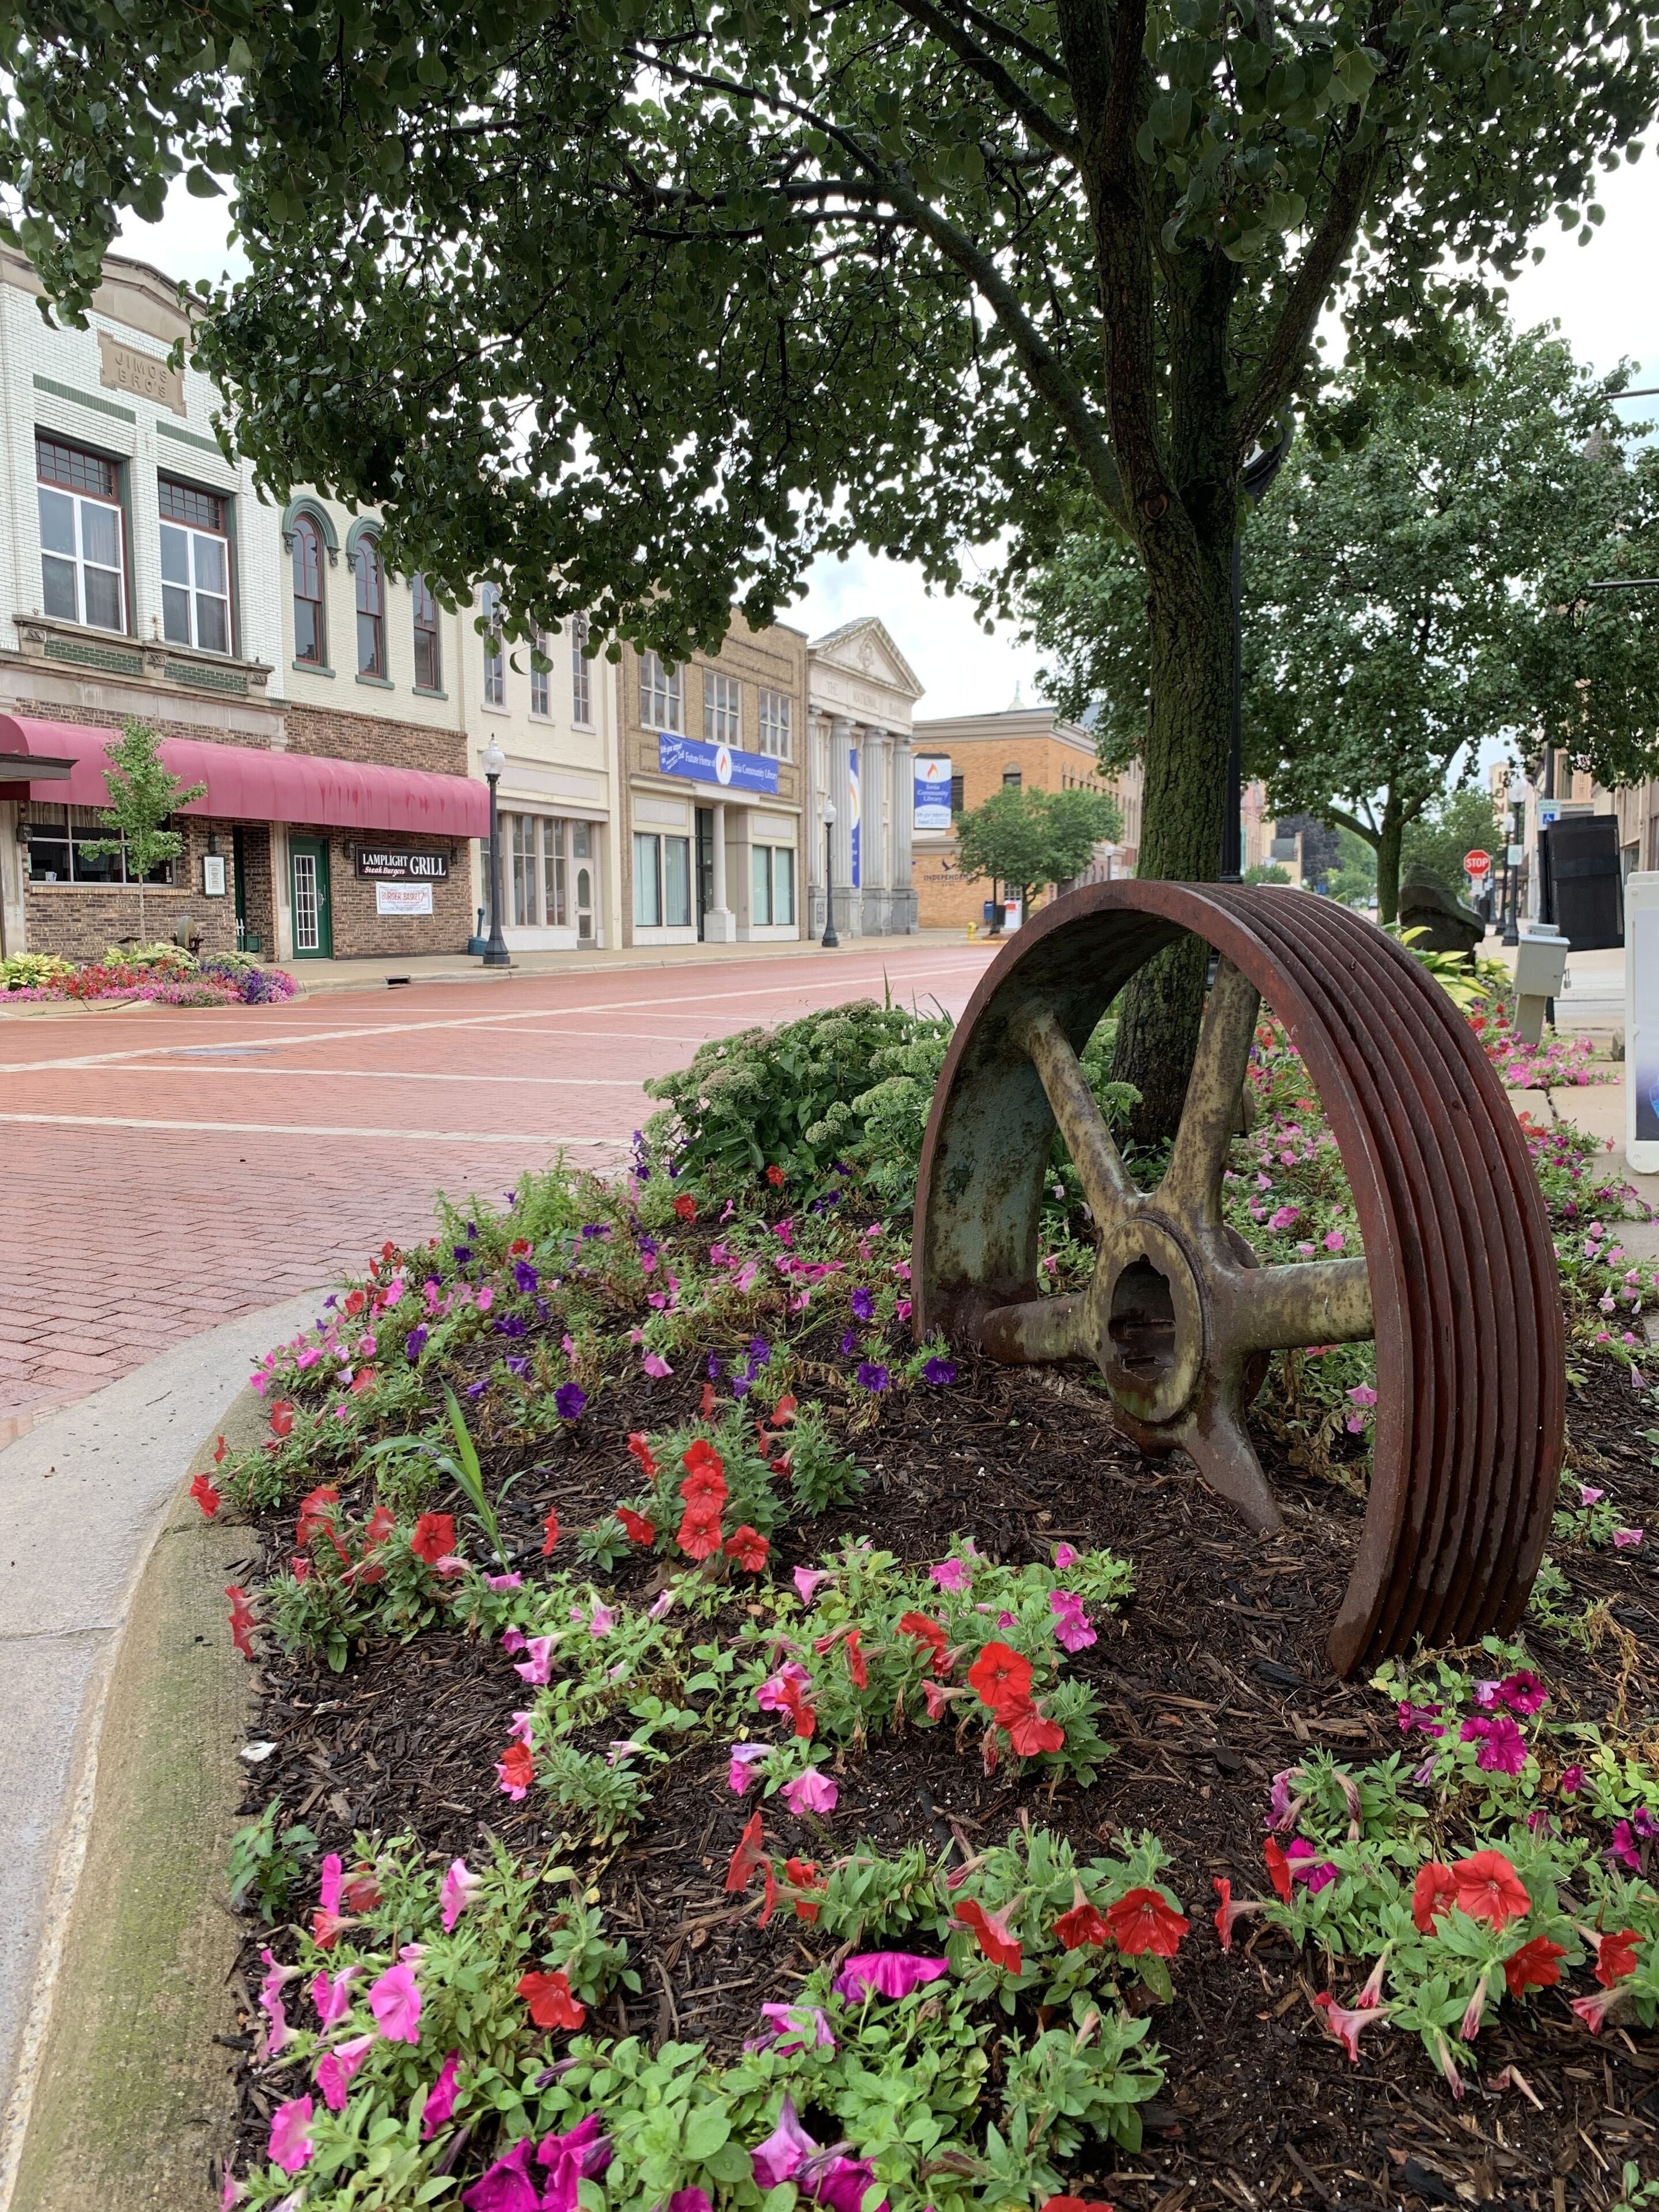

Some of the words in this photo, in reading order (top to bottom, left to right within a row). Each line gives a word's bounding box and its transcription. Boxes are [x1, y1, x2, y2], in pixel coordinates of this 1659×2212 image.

[116, 351, 167, 383] JIMOS
[119, 368, 166, 398] BRO'S
[685, 752, 699, 765] Future
[699, 755, 711, 766] Home
[743, 764, 765, 780] Community
[917, 790, 949, 798] Community
[362, 853, 408, 867] LAMPLIGHT
[410, 856, 446, 876] GRILL
[1466, 857, 1488, 868] STOP
[364, 866, 382, 874] Steak
[383, 867, 405, 877] Burgers
